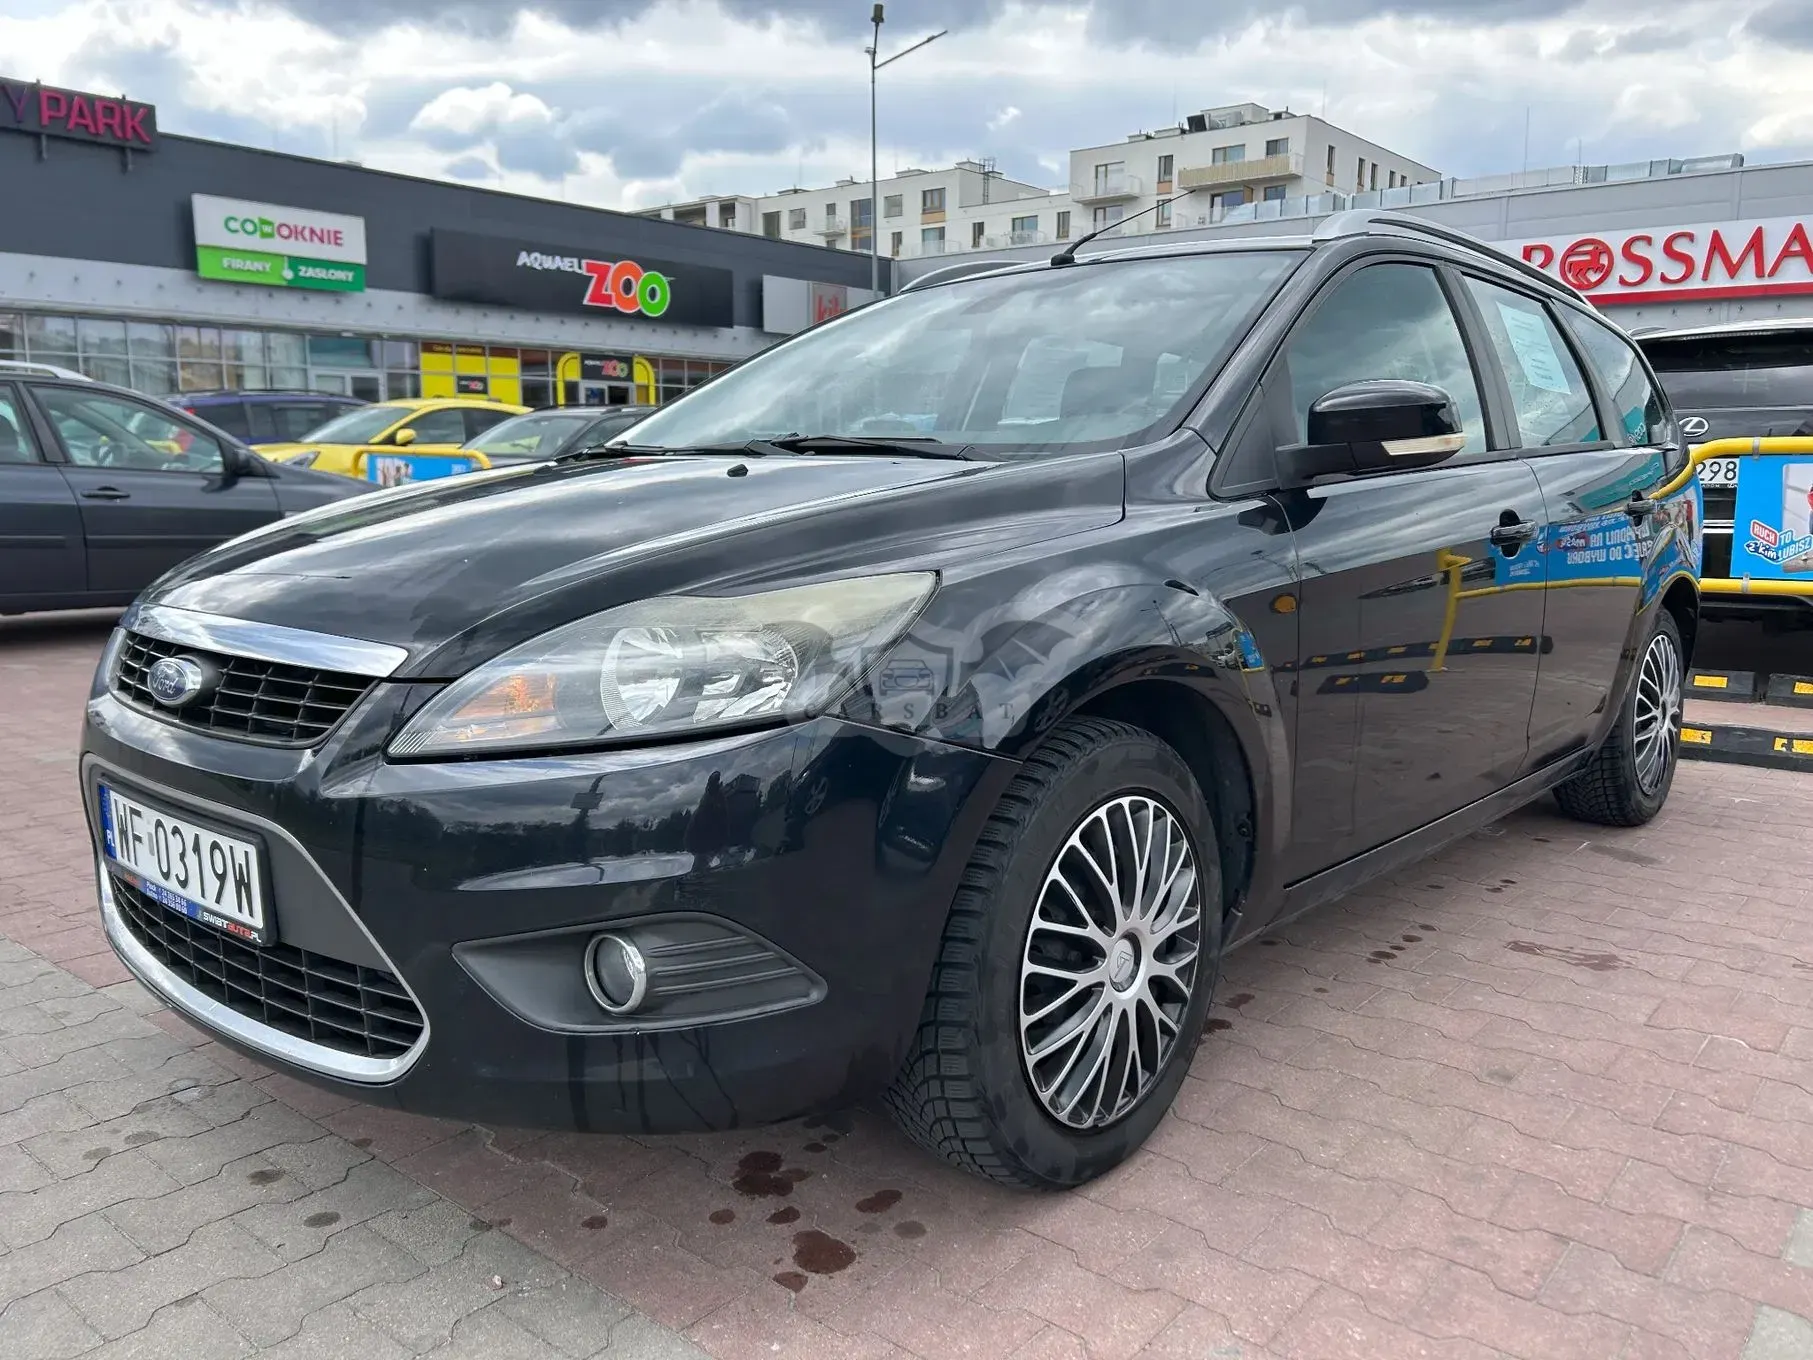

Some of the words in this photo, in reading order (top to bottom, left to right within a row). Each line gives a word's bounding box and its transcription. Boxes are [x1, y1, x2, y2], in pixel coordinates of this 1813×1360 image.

[39, 88, 152, 144] PARK
[223, 216, 257, 236] CO
[276, 222, 344, 247] OKNIE
[222, 257, 271, 273] FIRANY
[583, 260, 671, 317] ZOO
[601, 360, 629, 378] ZOO
[1753, 522, 1776, 544] RUCH
[1779, 531, 1793, 546] TO
[154, 668, 177, 695] Ford
[106, 829, 115, 847] PL
[113, 798, 143, 867] WF
[154, 817, 255, 919] 0319W
